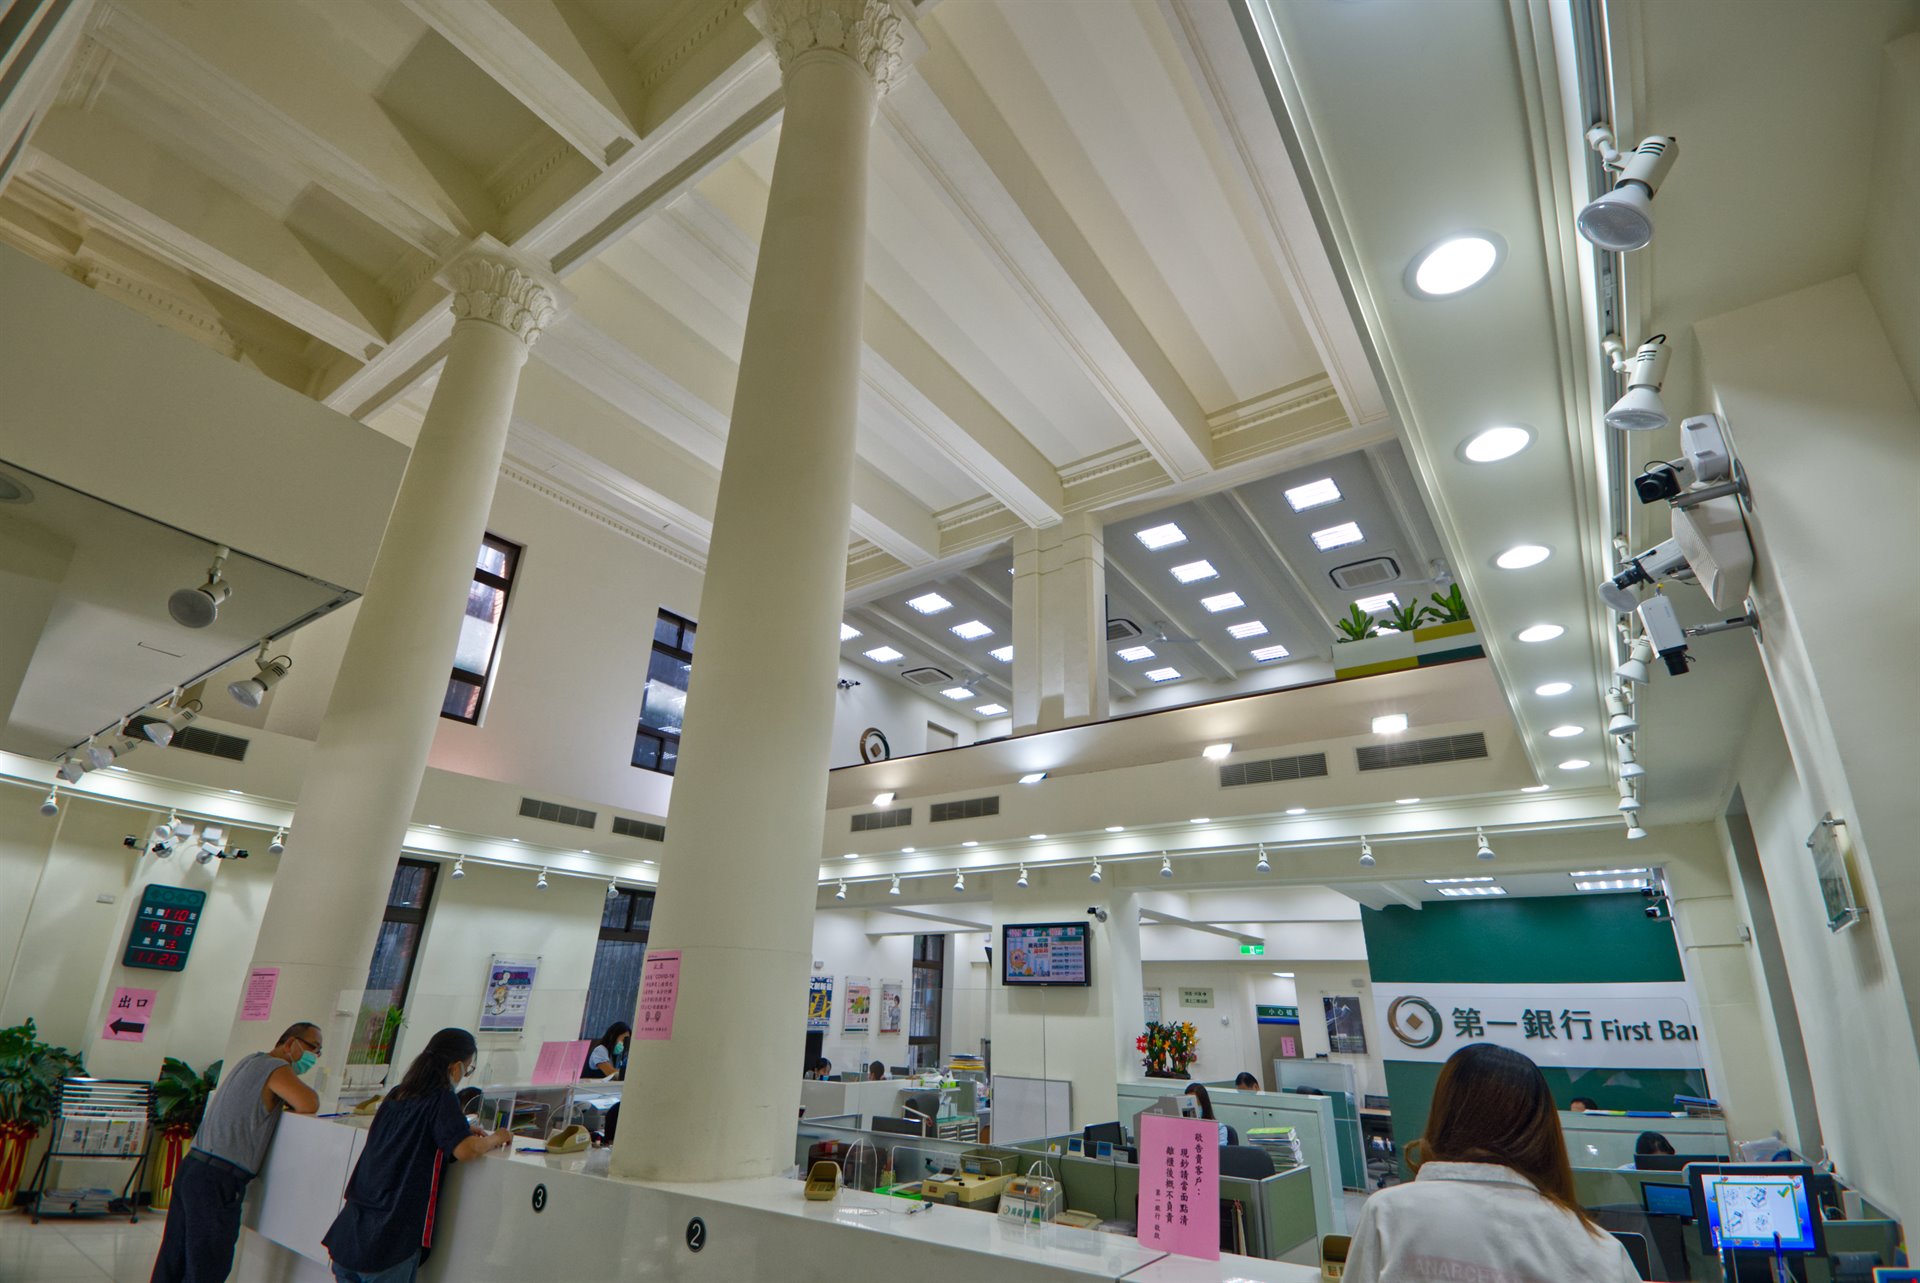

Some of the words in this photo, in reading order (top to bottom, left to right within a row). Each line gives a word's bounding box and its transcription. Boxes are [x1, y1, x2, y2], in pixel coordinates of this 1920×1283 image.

[118, 995, 148, 1008] 出口
[1452, 1007, 1593, 1041] 第一銀行
[1601, 1018, 1653, 1041] First
[535, 1188, 544, 1209] 3
[1165, 1145, 1175, 1223] 離櫃後概不負責
[1179, 1148, 1189, 1226] 現鈔請當面點清
[690, 1223, 701, 1247] 2
